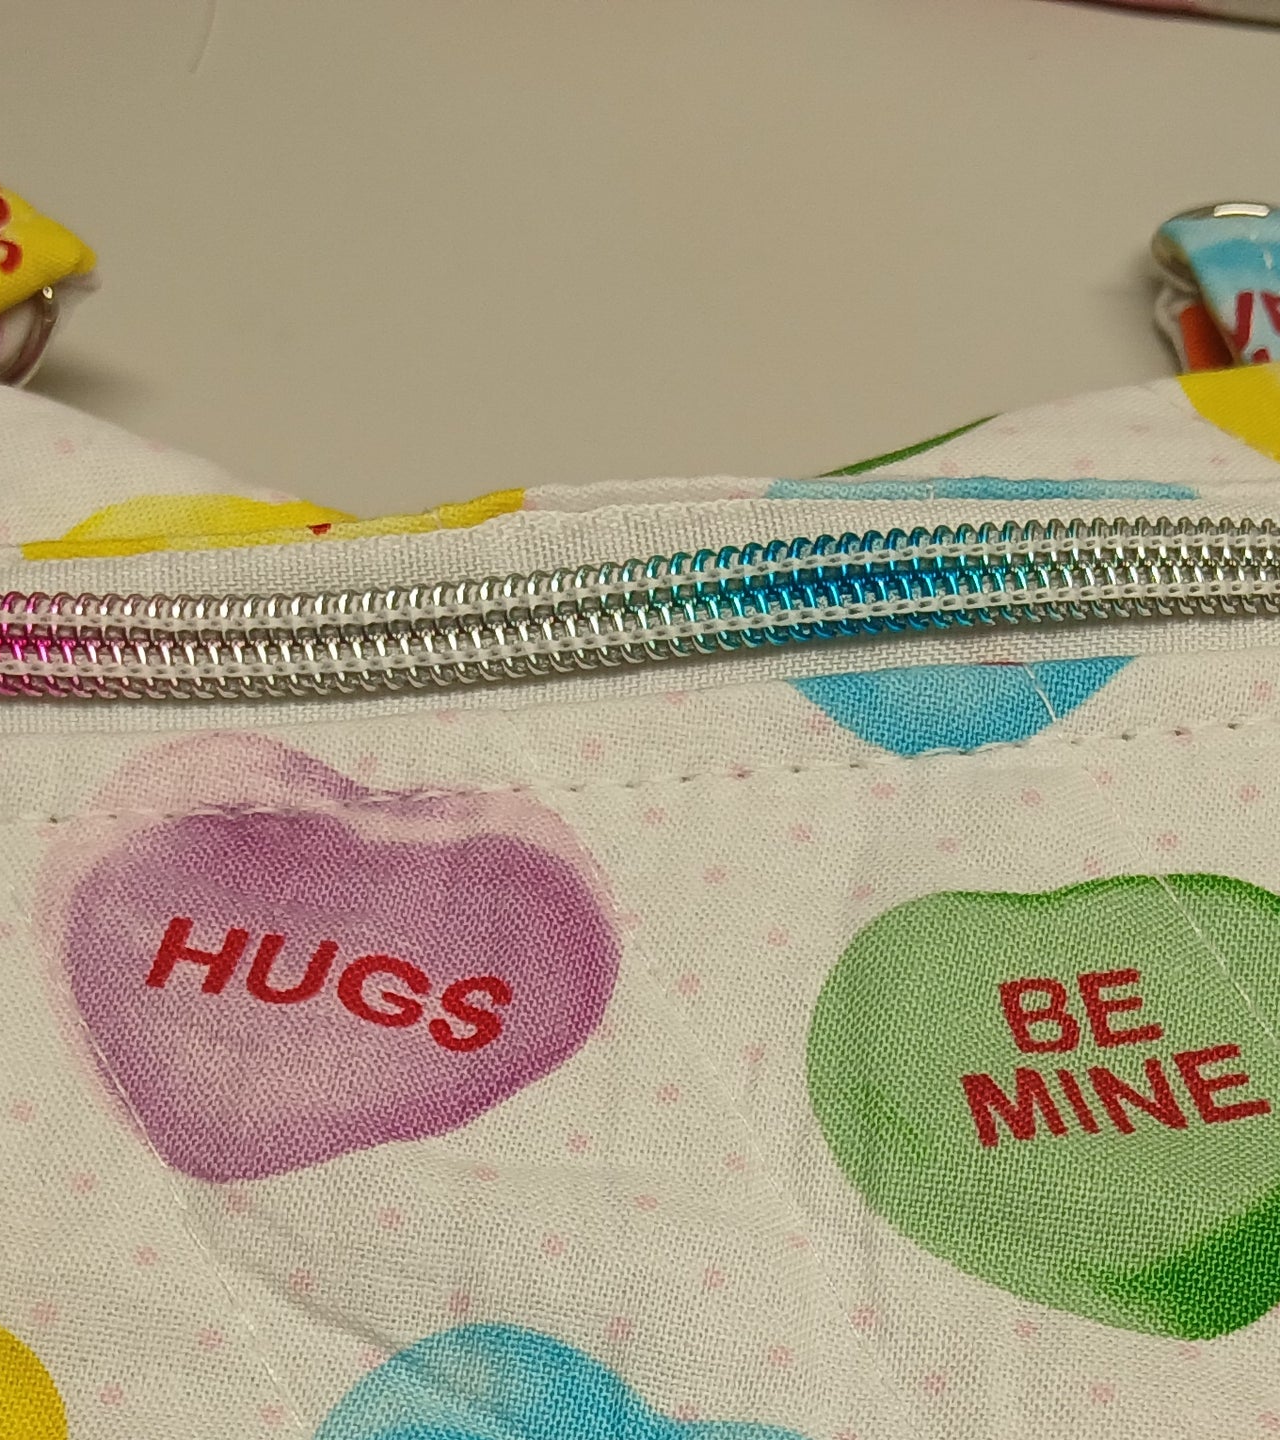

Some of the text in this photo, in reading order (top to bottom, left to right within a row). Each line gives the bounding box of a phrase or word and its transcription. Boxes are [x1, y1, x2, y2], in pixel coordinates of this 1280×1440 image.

[144, 915, 515, 1055] HUGS
[1000, 968, 1163, 1053] BE
[962, 1044, 1270, 1147] MINE
